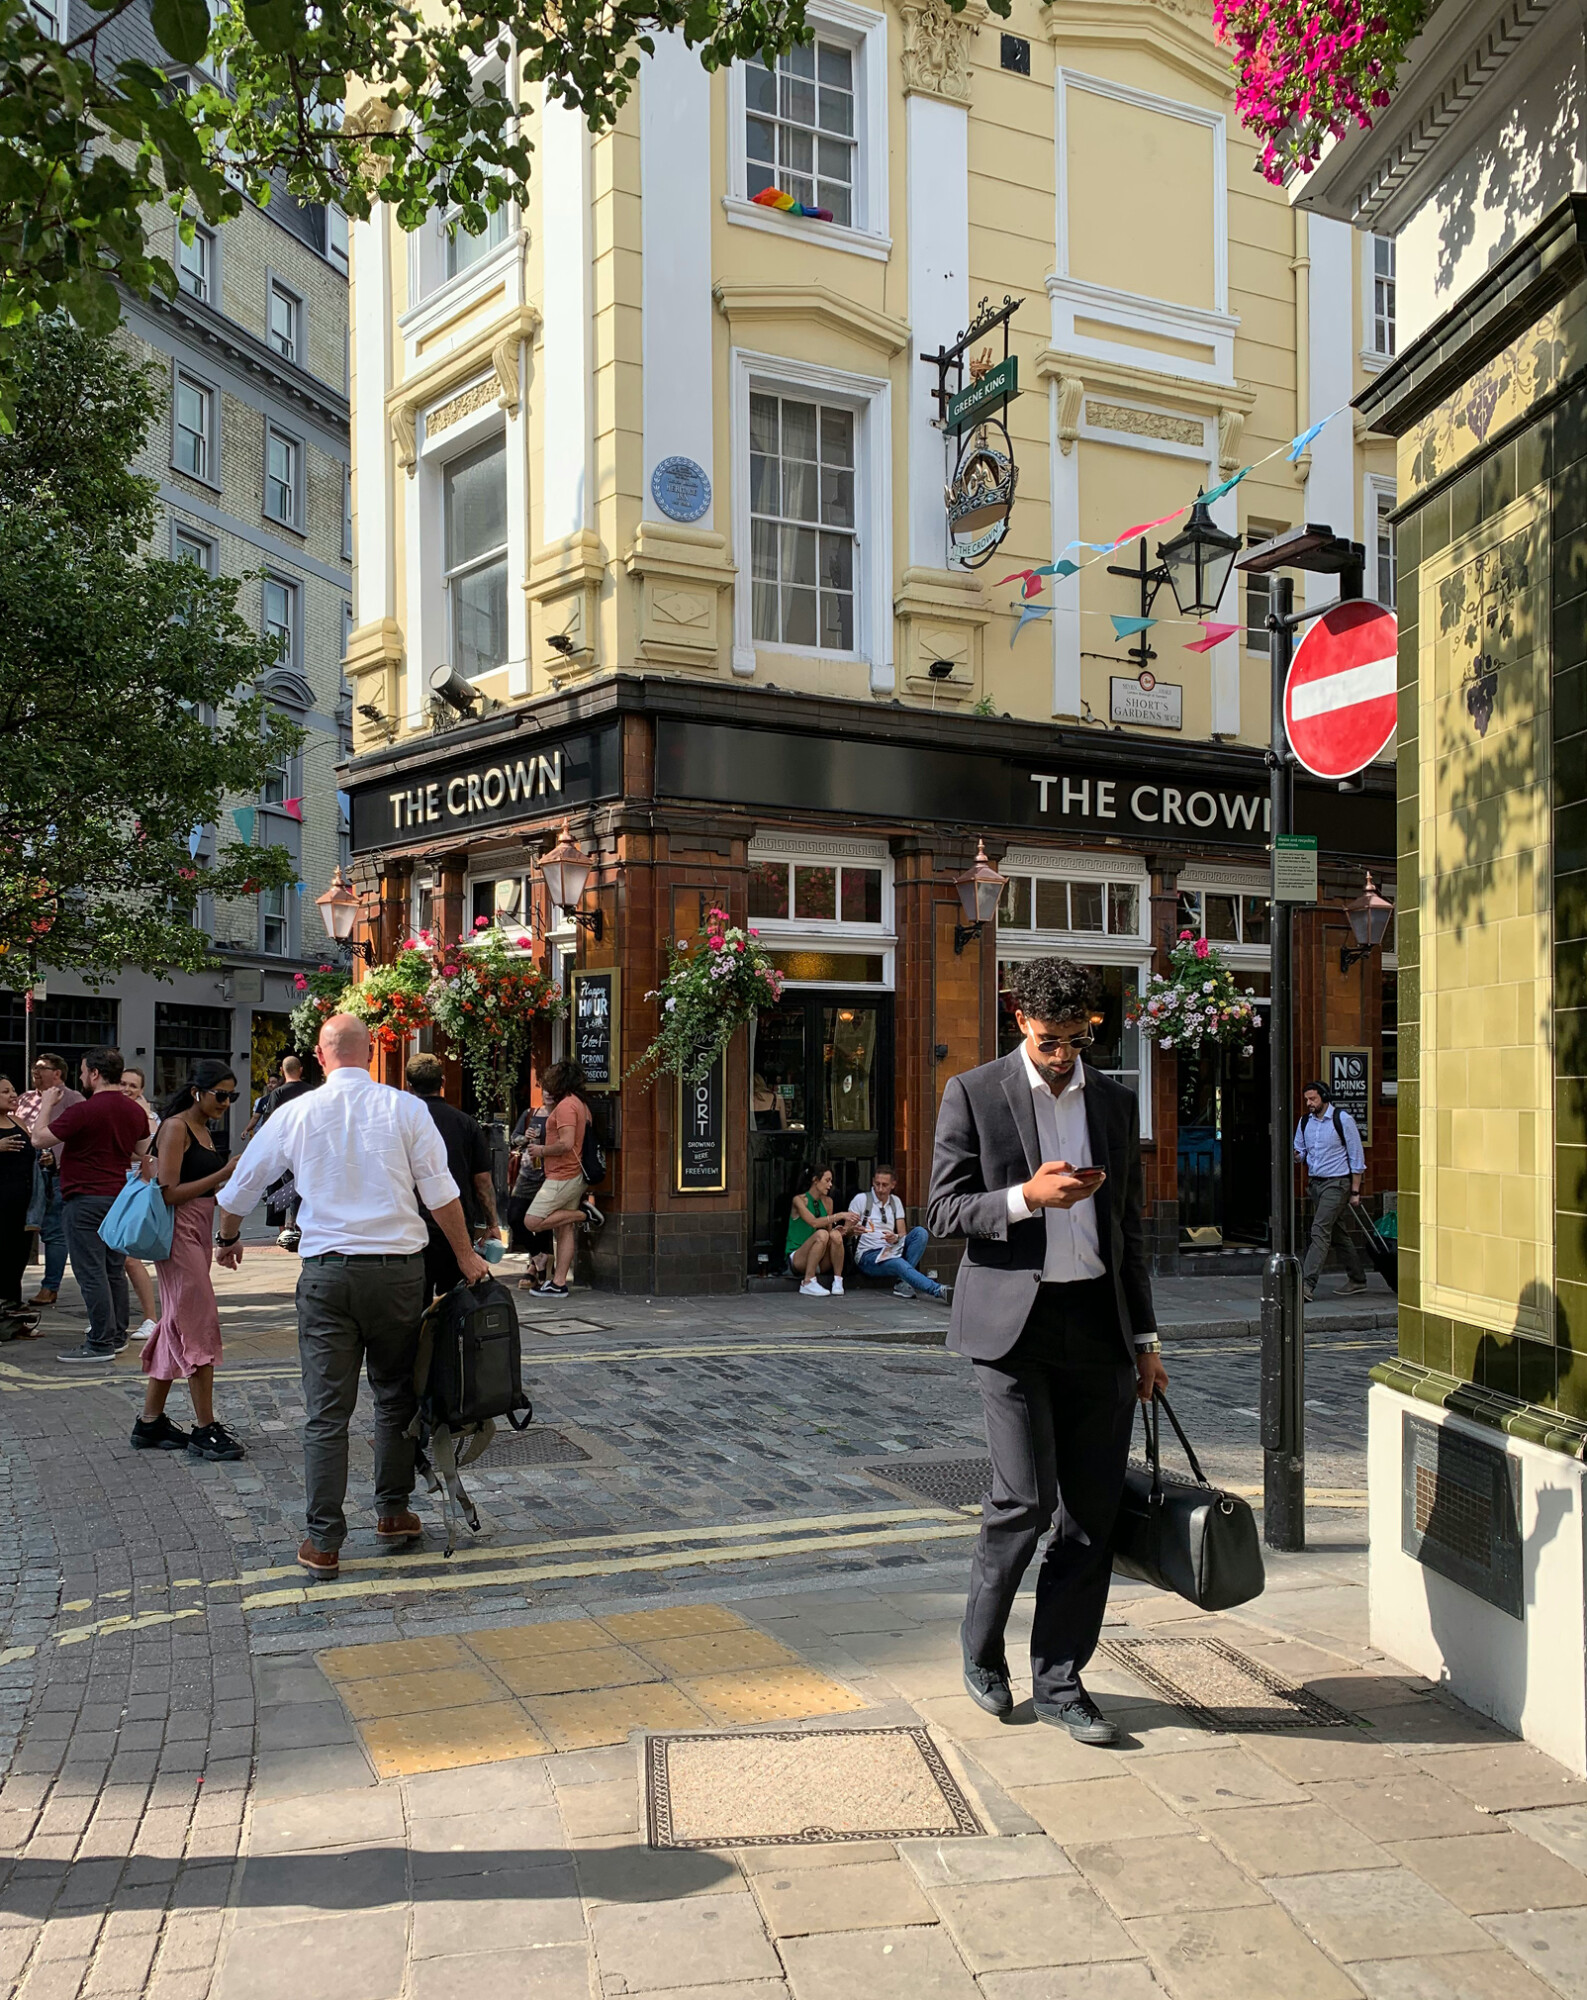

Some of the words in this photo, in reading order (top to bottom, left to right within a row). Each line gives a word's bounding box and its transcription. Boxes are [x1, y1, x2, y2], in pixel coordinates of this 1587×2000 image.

[953, 388, 984, 416] GREENE
[984, 373, 1006, 396] KING
[958, 545, 971, 554] THE
[972, 524, 999, 553] CROWN
[1114, 706, 1162, 721] GARDENS
[1126, 697, 1169, 712] SHORT'S
[389, 782, 441, 829] THE
[446, 750, 562, 816] CROWN
[1030, 773, 1117, 818] THE
[1130, 785, 1272, 832] CROW
[580, 981, 607, 998] Happy
[578, 998, 609, 1017] HOUR
[581, 1053, 604, 1064] PERONI
[1334, 1056, 1363, 1079] NO
[1334, 1080, 1366, 1091] DRINKS
[694, 1152, 709, 1160] HERE
